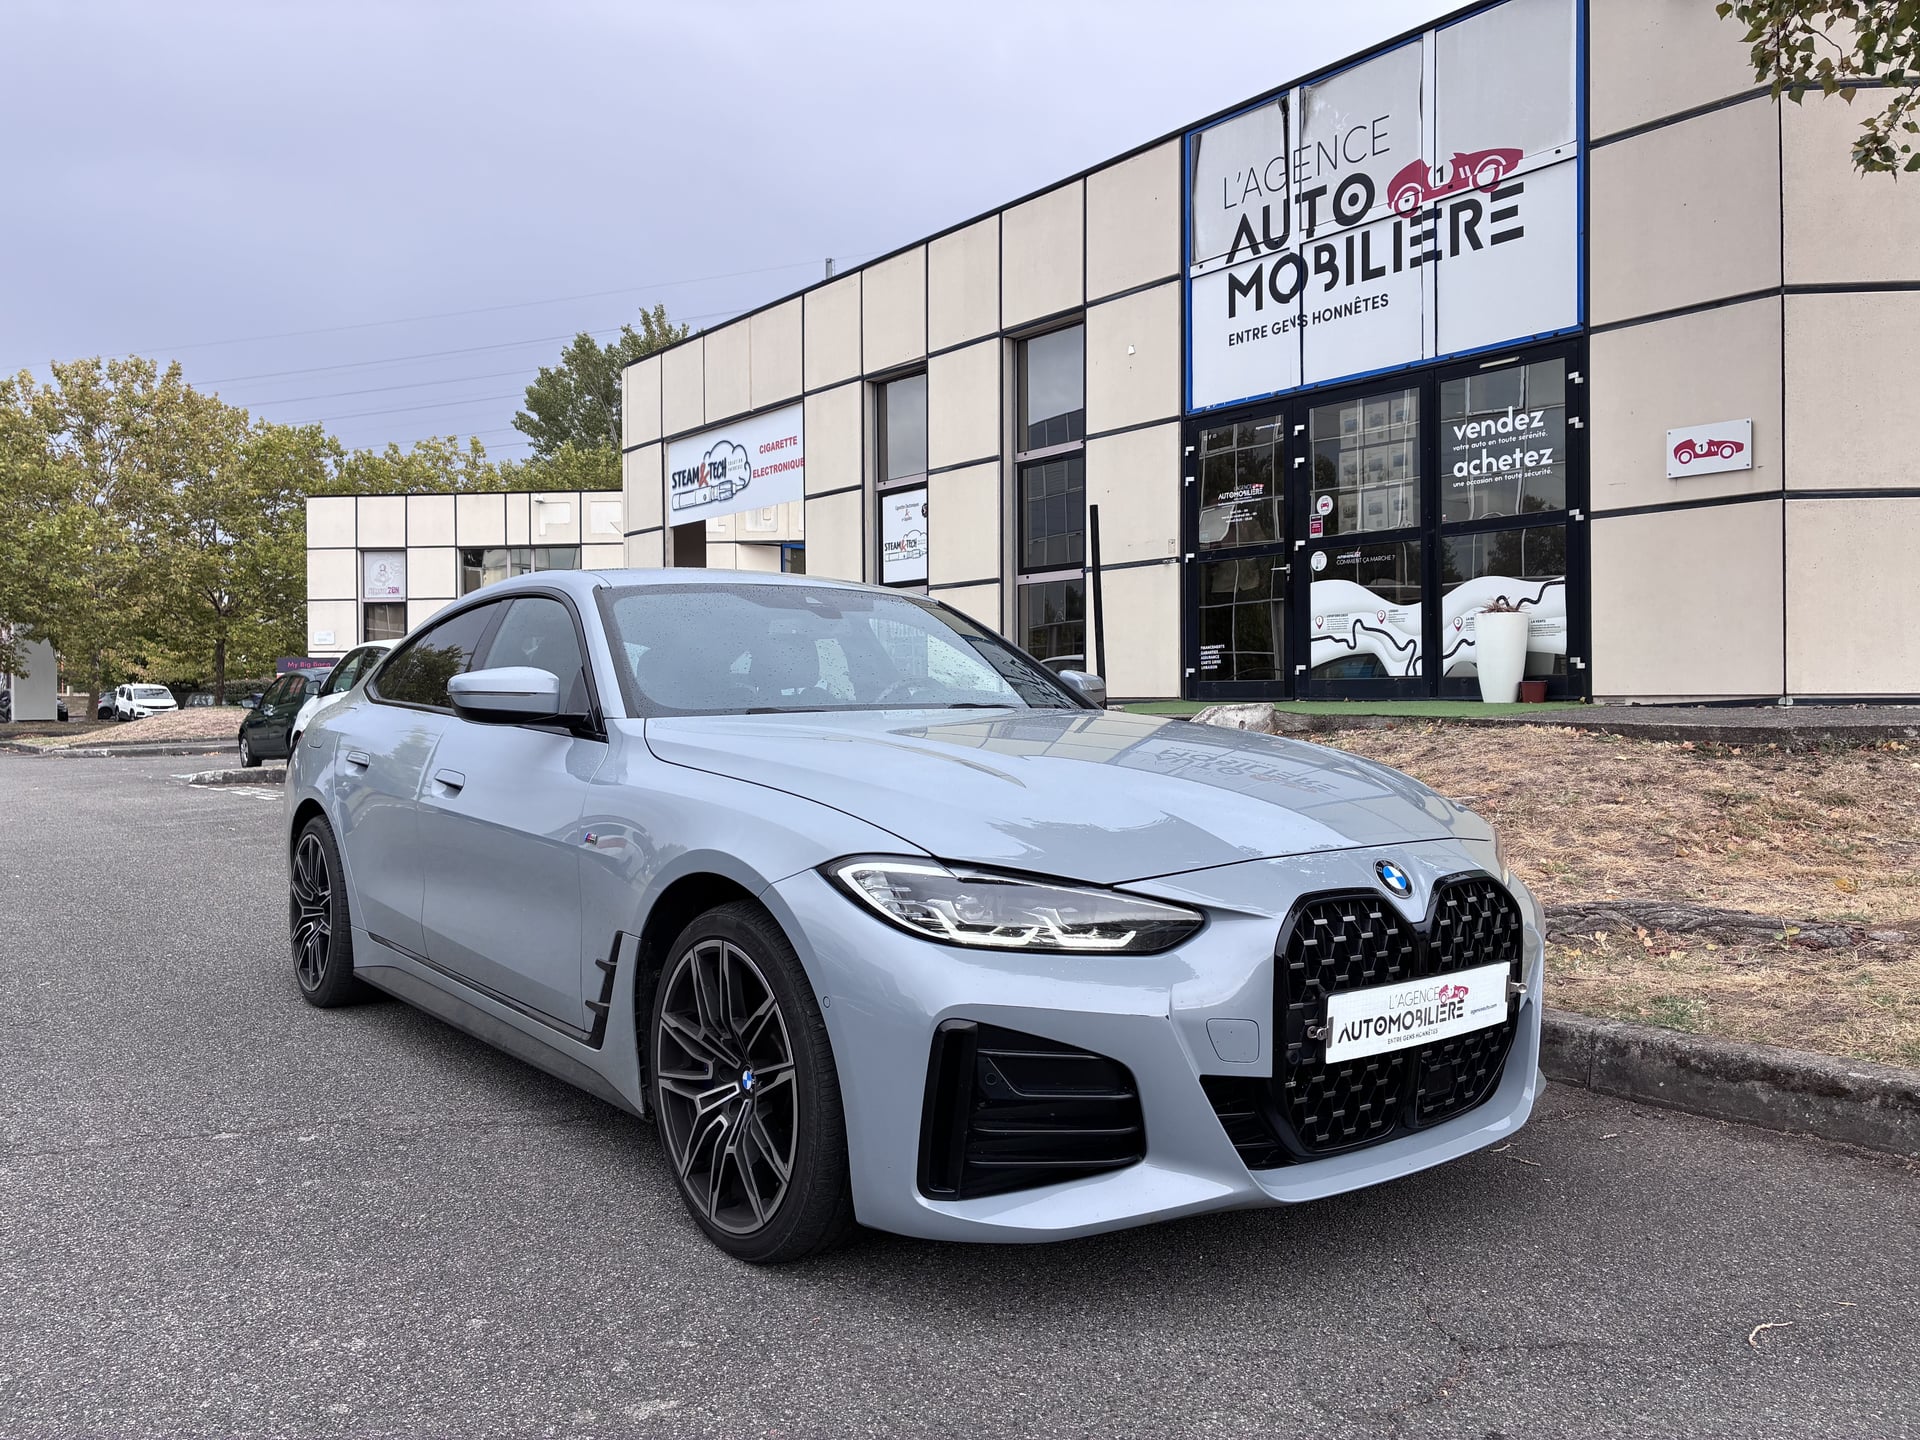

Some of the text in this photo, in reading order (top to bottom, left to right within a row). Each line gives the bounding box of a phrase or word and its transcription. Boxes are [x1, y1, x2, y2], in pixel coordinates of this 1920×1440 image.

[1224, 114, 1390, 210] L'AGENCE
[1225, 172, 1376, 264] AUTO
[1228, 293, 1390, 347] ENTRE GENS HONNÊTES
[1453, 406, 1544, 441] vendez
[759, 435, 798, 455] CIGARETTE
[1453, 442, 1470, 451] votre
[1471, 440, 1487, 449] auto
[1498, 436, 1517, 444] toute
[752, 457, 805, 479] ELECTRONIQUE
[1453, 448, 1554, 478] achetez
[1453, 467, 1553, 489] une occasion en toute sécurité.
[287, 661, 298, 669] My
[1389, 985, 1440, 1010] L'AGENCE
